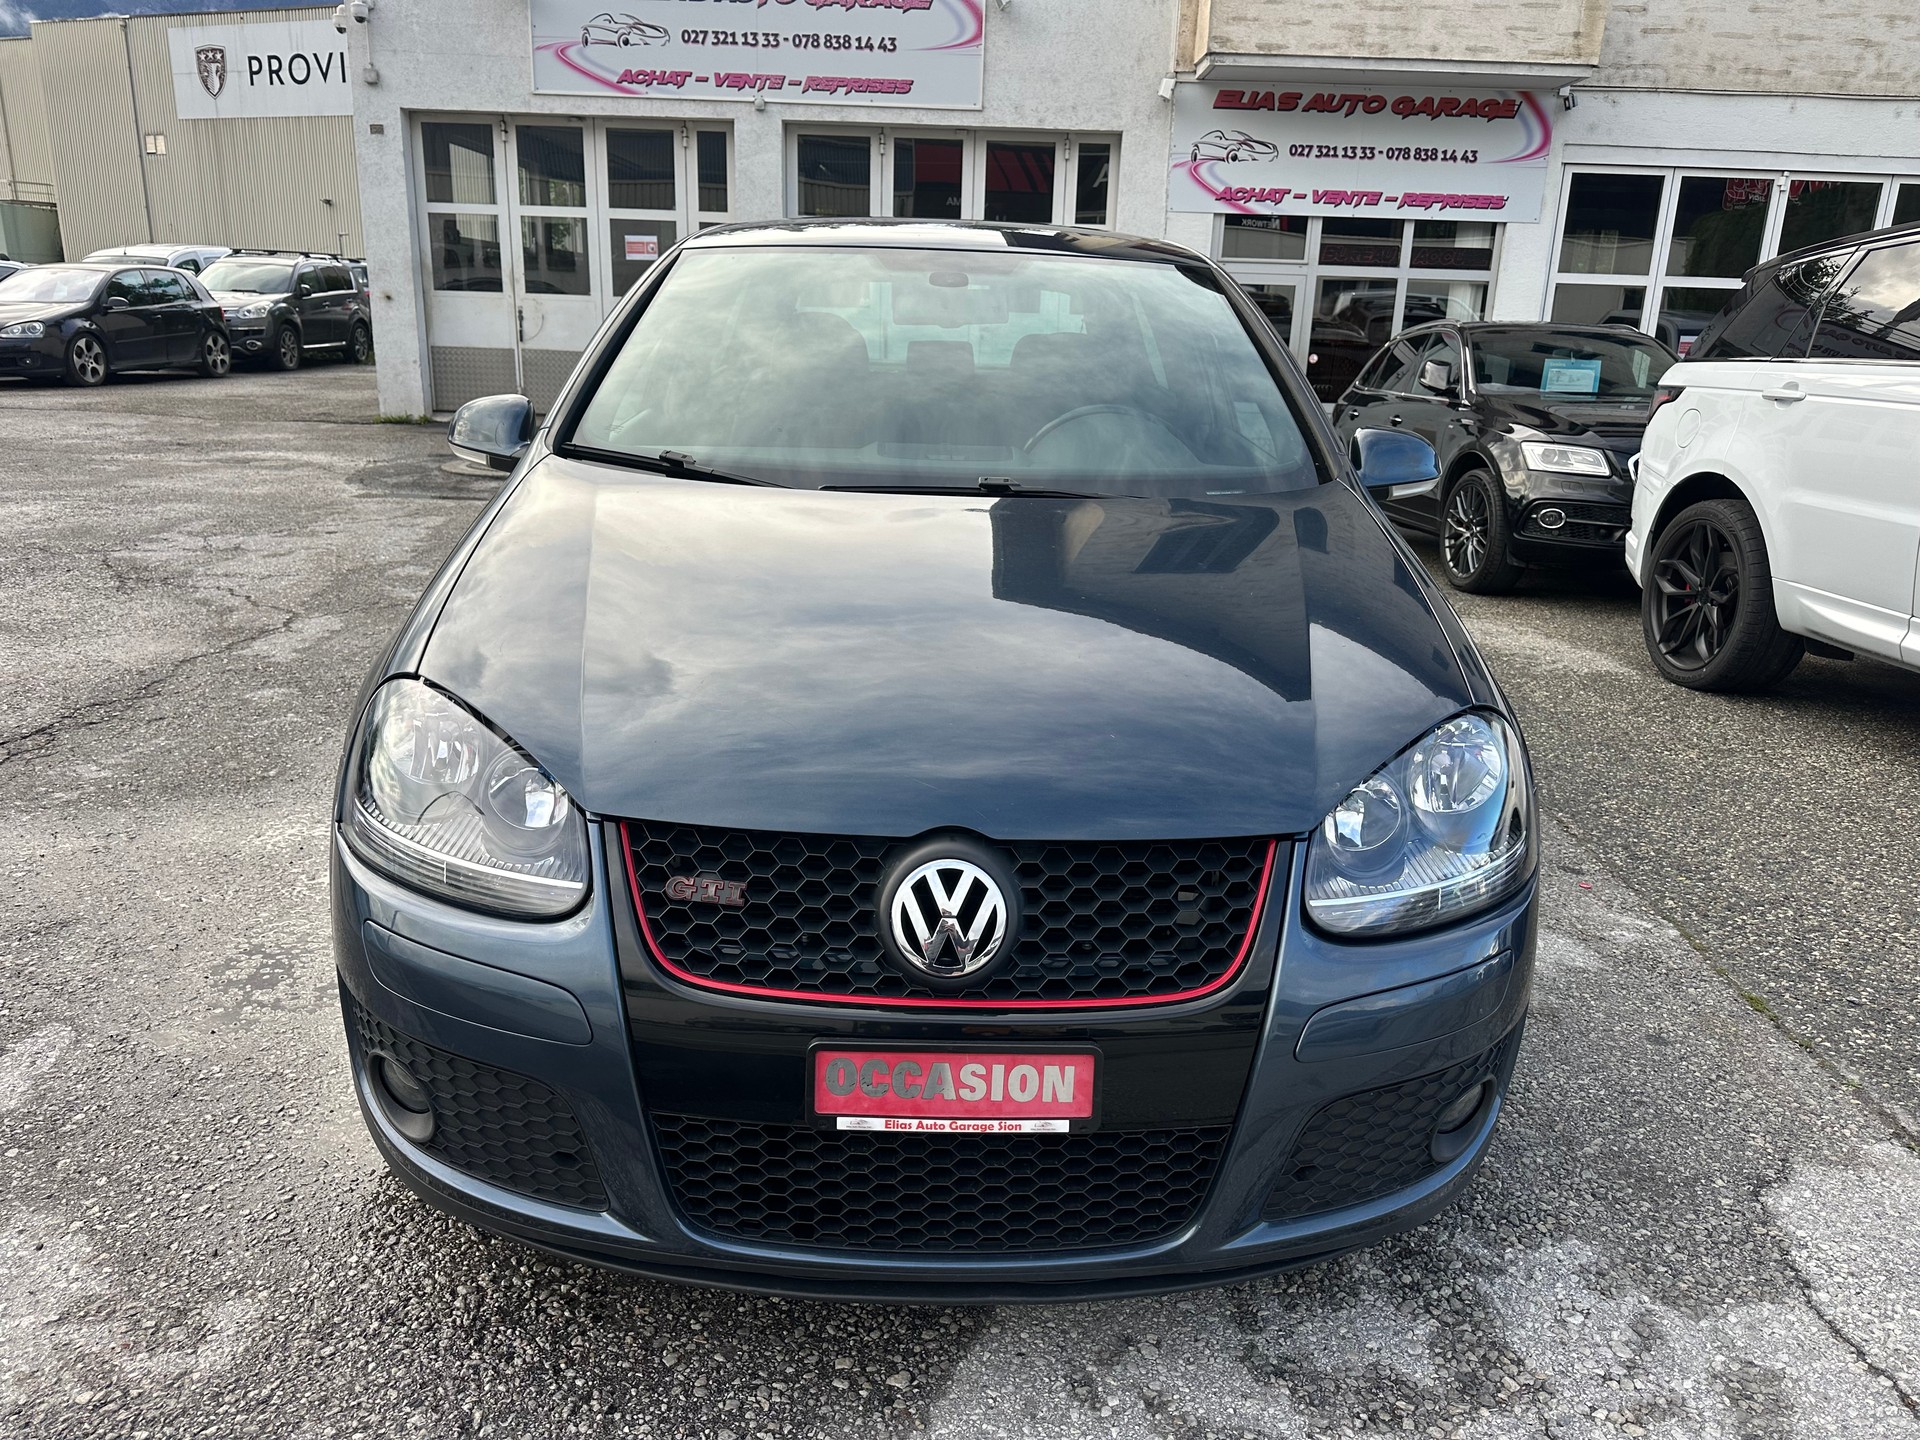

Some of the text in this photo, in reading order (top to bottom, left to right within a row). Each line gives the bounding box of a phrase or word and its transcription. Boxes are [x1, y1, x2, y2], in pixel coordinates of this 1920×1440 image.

[681, 29, 708, 45] 027
[711, 30, 738, 45] 321
[741, 31, 759, 47] 13
[761, 33, 780, 48] 33
[792, 33, 820, 49] 078
[823, 34, 851, 49] 838
[855, 36, 874, 51] 14
[877, 37, 897, 52] 43
[247, 51, 346, 86] PROVI
[617, 69, 693, 89] ACHAT
[714, 72, 786, 92] VENTE
[802, 76, 914, 95] REPRISES
[1213, 89, 1523, 123] ELIAS AUTO GARAGE
[1289, 144, 1313, 158] 027
[1315, 145, 1339, 158] 321
[1341, 146, 1357, 160] 13
[1359, 146, 1375, 160] 33
[1386, 147, 1411, 161] 078
[1413, 147, 1438, 161] 838
[1440, 149, 1458, 163] 14
[1460, 149, 1478, 164] 43
[1215, 187, 1291, 206] ACHAT
[1312, 190, 1383, 209] VENTE
[1397, 192, 1509, 211] REPRISES
[665, 875, 747, 907] GTI
[825, 1057, 1076, 1103] OCCASION
[884, 1119, 1022, 1133] Elias Auto Garage Sion
